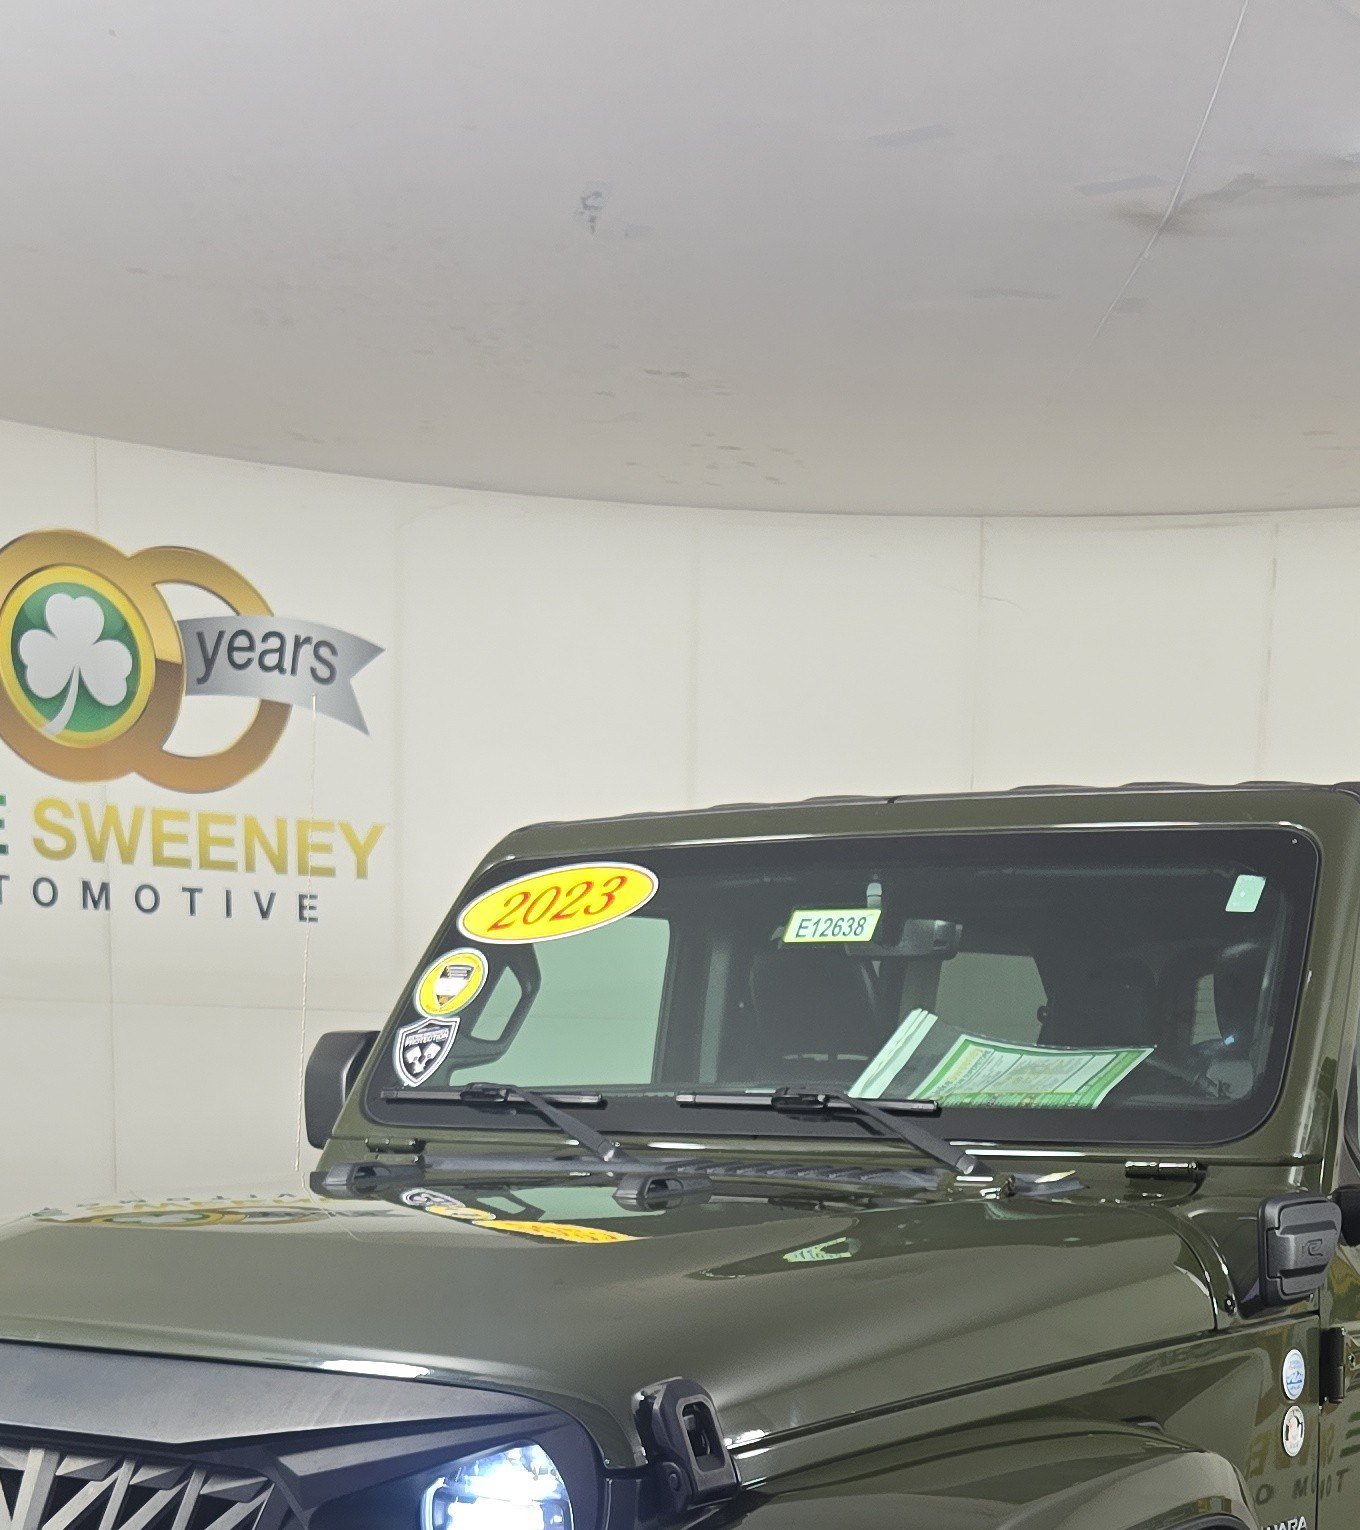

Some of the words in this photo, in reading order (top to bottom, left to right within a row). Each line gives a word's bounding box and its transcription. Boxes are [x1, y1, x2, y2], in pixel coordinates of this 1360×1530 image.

[195, 628, 338, 686] years
[32, 798, 386, 880] SWEENEY
[487, 876, 627, 932] 2023
[795, 916, 867, 939] E12638
